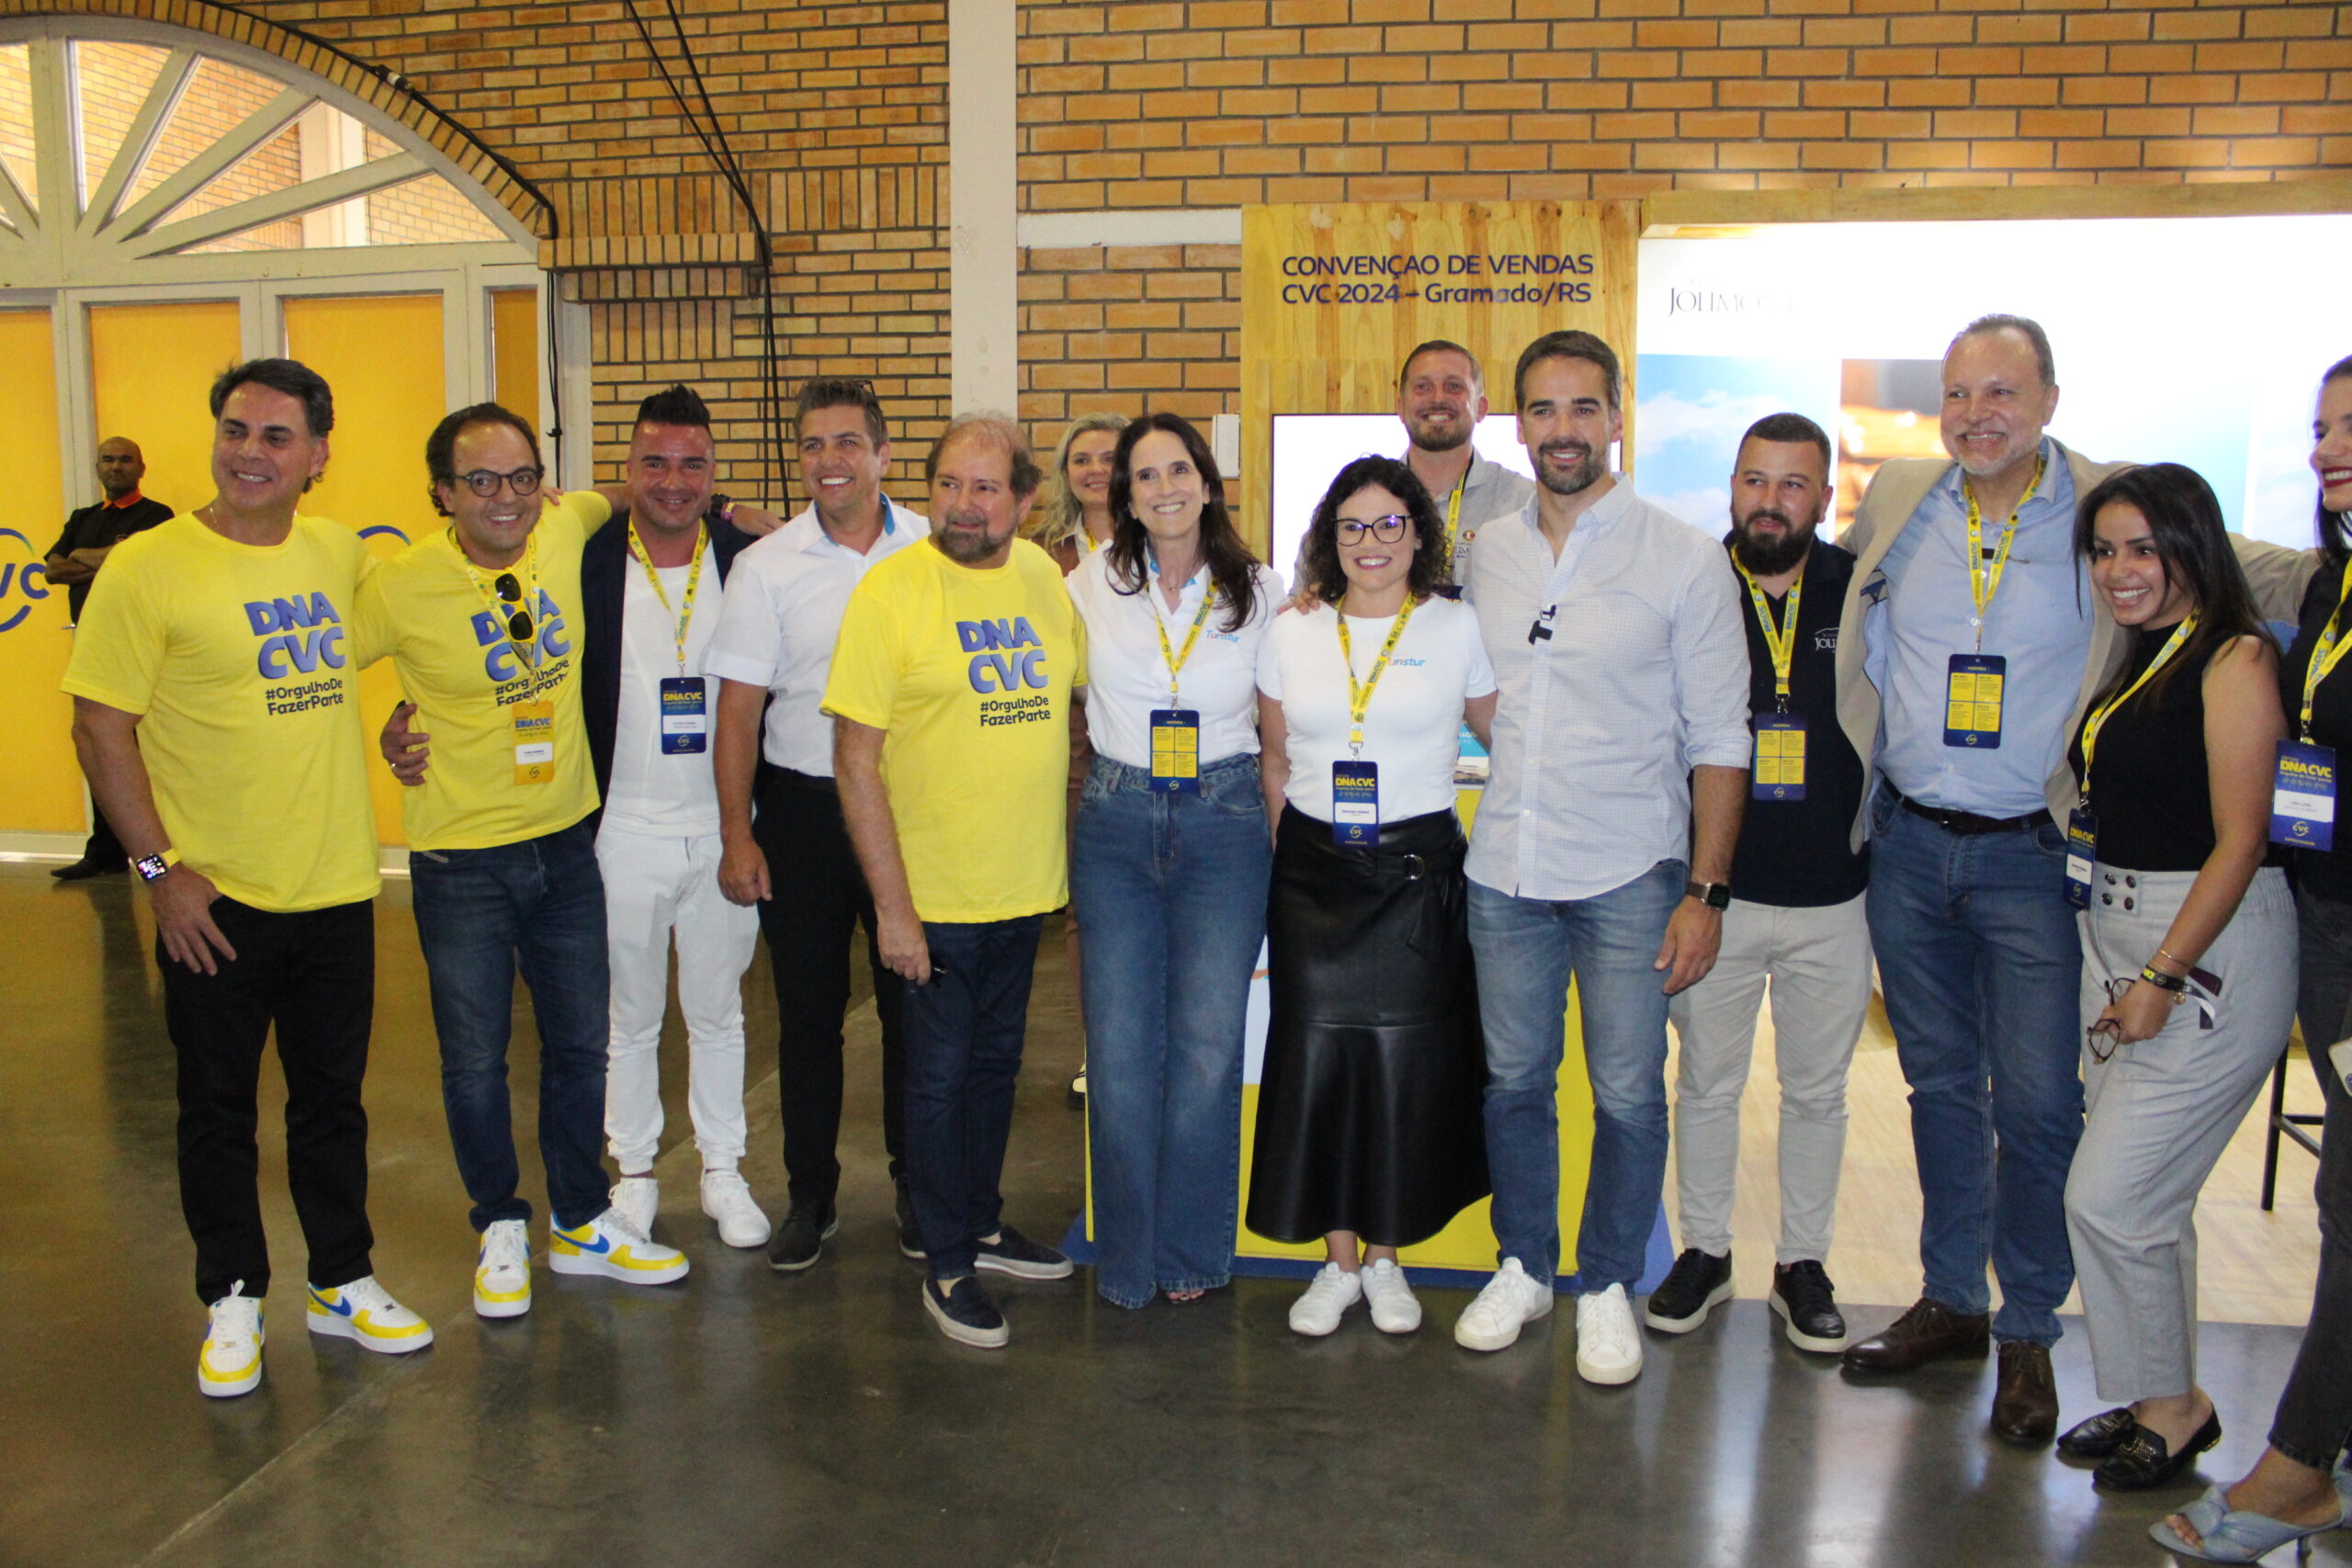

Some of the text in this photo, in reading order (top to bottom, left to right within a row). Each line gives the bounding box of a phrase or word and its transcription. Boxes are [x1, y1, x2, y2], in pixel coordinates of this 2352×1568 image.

[1448, 254, 1480, 274] DE
[1488, 254, 1594, 275] VENDAS
[1282, 284, 1331, 304] CVC
[1338, 284, 1401, 303] 2024
[1425, 282, 1592, 306] Gramado/RS
[243, 592, 341, 637] DNA
[470, 589, 560, 647] DA
[956, 616, 1043, 652] DNA
[258, 626, 345, 680] CVC
[495, 660, 570, 695] #OrglhoDe
[968, 649, 1048, 694] CVC
[266, 678, 343, 701] #OrgulhoDe
[267, 693, 345, 716] FazerParte
[980, 695, 1049, 713] #OrgulhoDe
[980, 709, 1051, 727] FazerParte
[2280, 760, 2332, 778] DNA CVC
[1356, 778, 1375, 787] CVC
